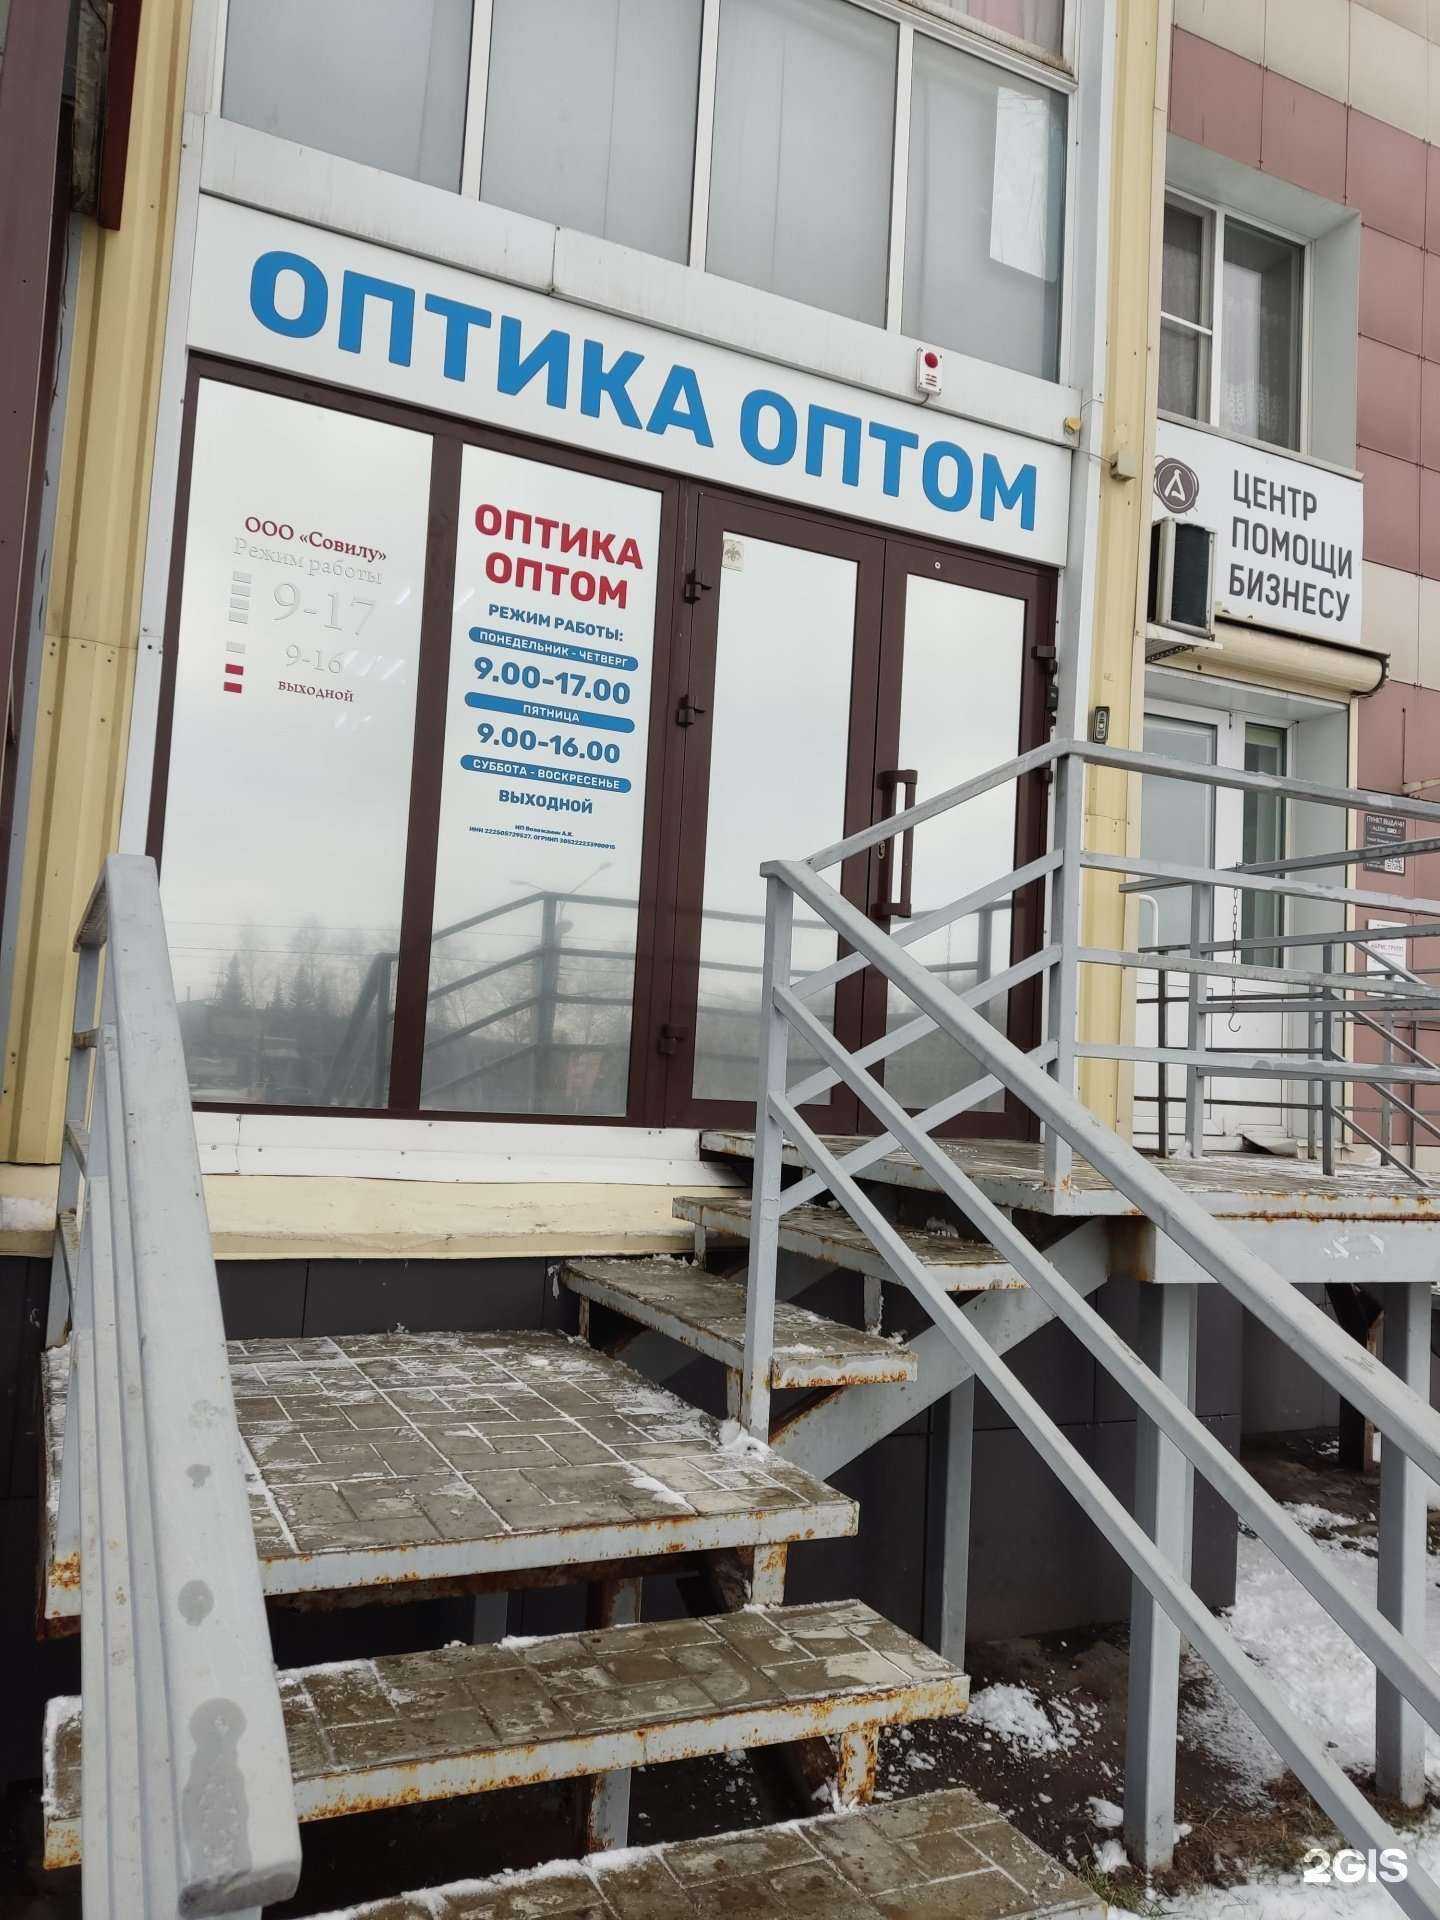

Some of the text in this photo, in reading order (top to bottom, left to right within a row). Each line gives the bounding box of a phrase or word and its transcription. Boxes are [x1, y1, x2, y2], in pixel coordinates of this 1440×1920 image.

[249, 250, 1038, 531] ОПТИКА ОПТОМ
[1233, 470, 1318, 521] ЦЕНТР
[245, 516, 386, 562] ООО «Совилу»
[474, 503, 643, 570] ОПТИКА
[1231, 516, 1353, 580] ПОМОЩИ
[232, 537, 383, 585] Режим работы
[485, 551, 628, 610] ОПТОМ
[272, 583, 375, 637] 9-17
[1229, 563, 1350, 622] БИЗНЕСУ
[488, 603, 623, 642] РЕЖИМ РАБОТЫ:
[284, 644, 345, 674] 9-16
[479, 630, 569, 657] ПОНЕДЕЛЬНИК
[579, 651, 629, 668] ЧЕТВЕРГ
[277, 681, 354, 702] выходной
[474, 656, 631, 705] 9.00-17.00
[523, 704, 580, 722] ПЯТНИЦА
[477, 722, 620, 764] 9.00-16.00
[472, 758, 528, 776] СУББОТА
[537, 769, 620, 790] ВОСКРЕСЕНЬЕ
[498, 789, 593, 814] ВЫХОДНОЙ
